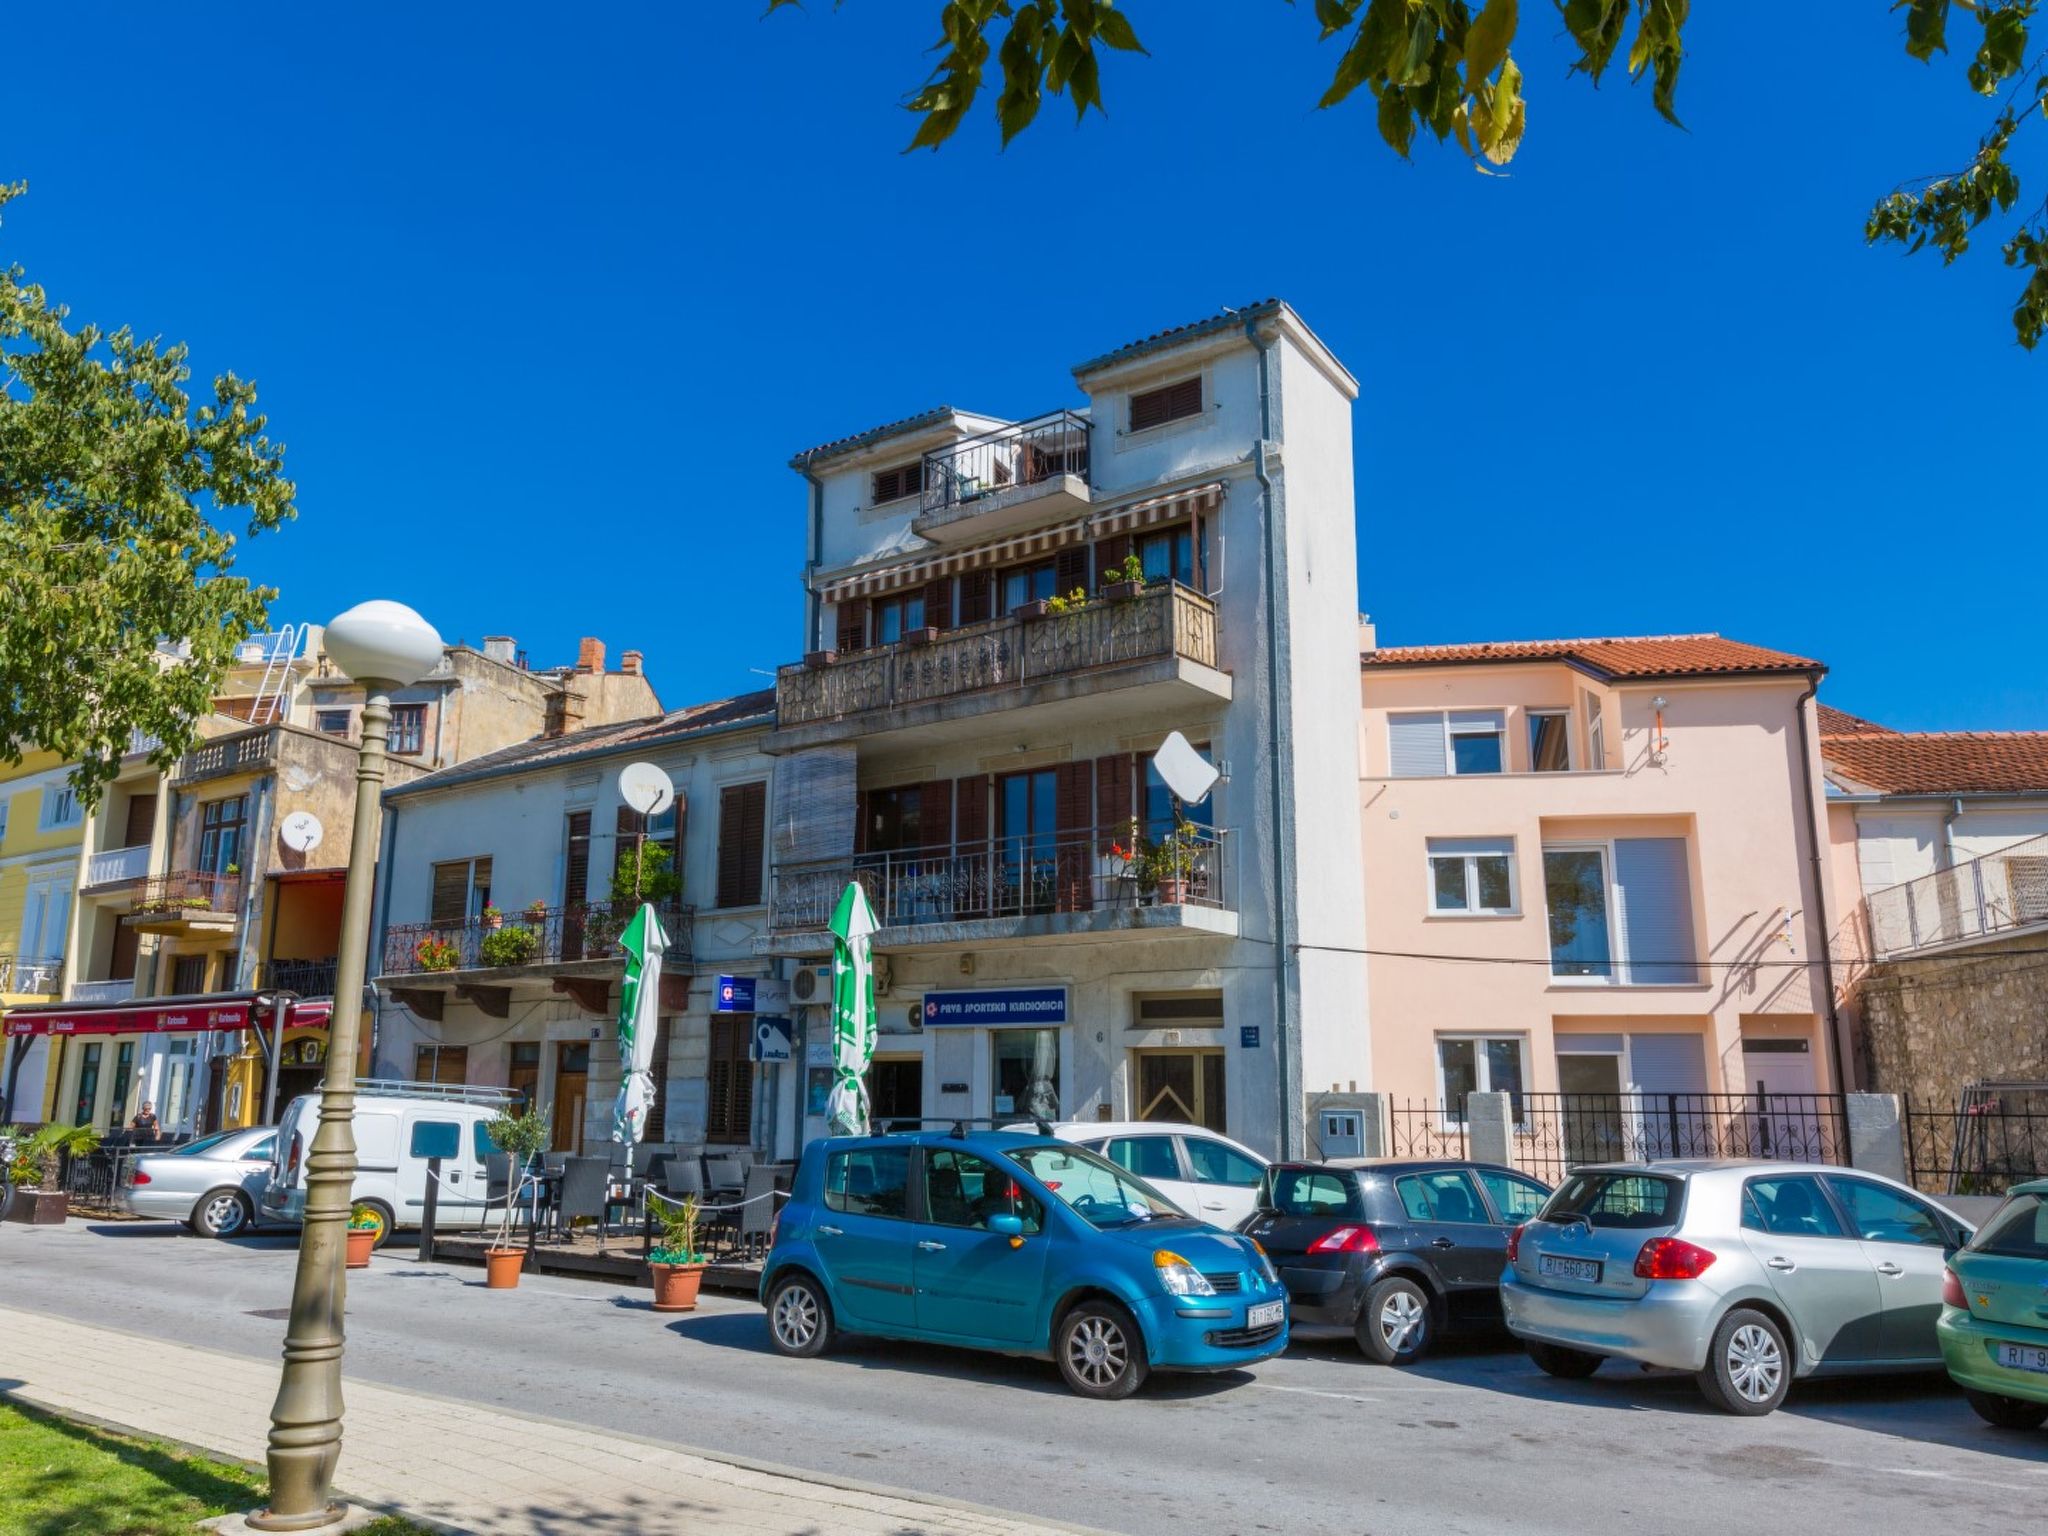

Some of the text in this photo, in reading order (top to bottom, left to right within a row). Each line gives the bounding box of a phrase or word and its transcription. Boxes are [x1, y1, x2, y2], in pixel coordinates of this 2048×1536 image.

[940, 1000, 1064, 1014] PRVA SPORTSKA KLADIONICA
[1096, 1031, 1104, 1043] 6
[1547, 1258, 1557, 1274] RI
[2008, 1347, 2048, 1368] RI 9
